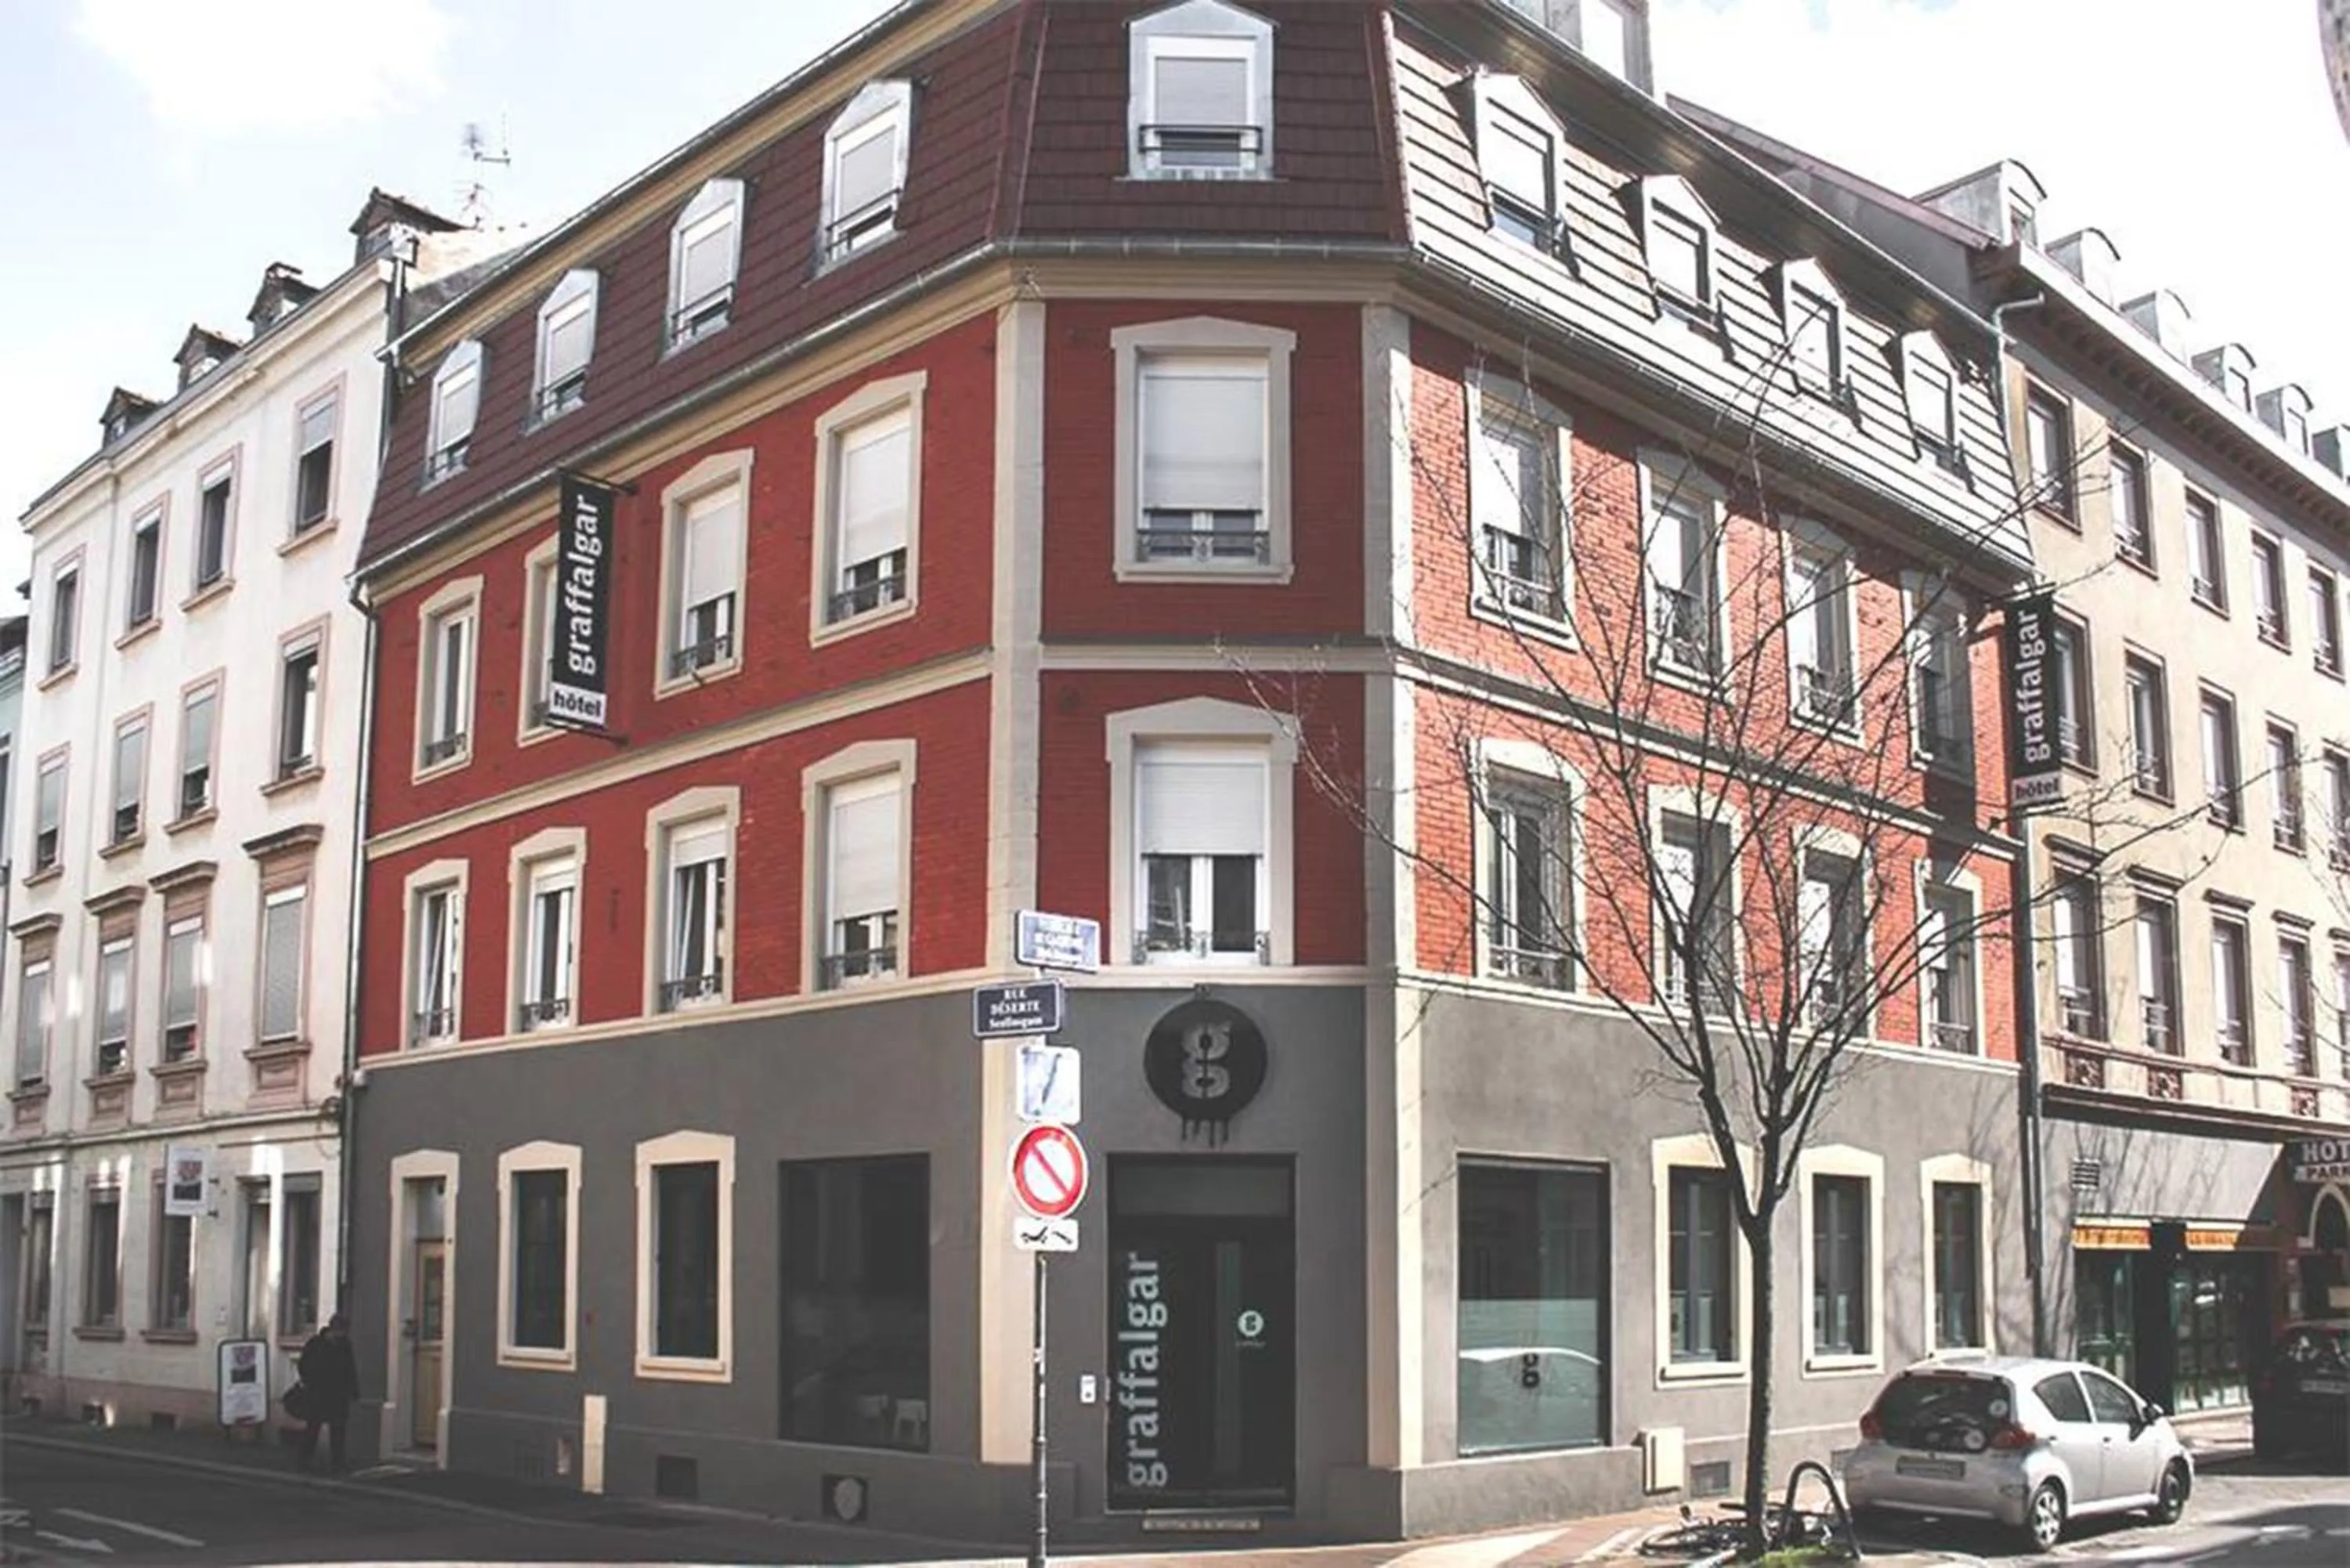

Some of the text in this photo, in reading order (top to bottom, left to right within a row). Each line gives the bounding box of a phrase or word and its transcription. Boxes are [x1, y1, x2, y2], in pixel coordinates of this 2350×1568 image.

[564, 494, 602, 676] graffalgar
[554, 690, 601, 717] hôtel
[2015, 610, 2051, 764] graffalgar
[1118, 1251, 1169, 1487] graffalgar
